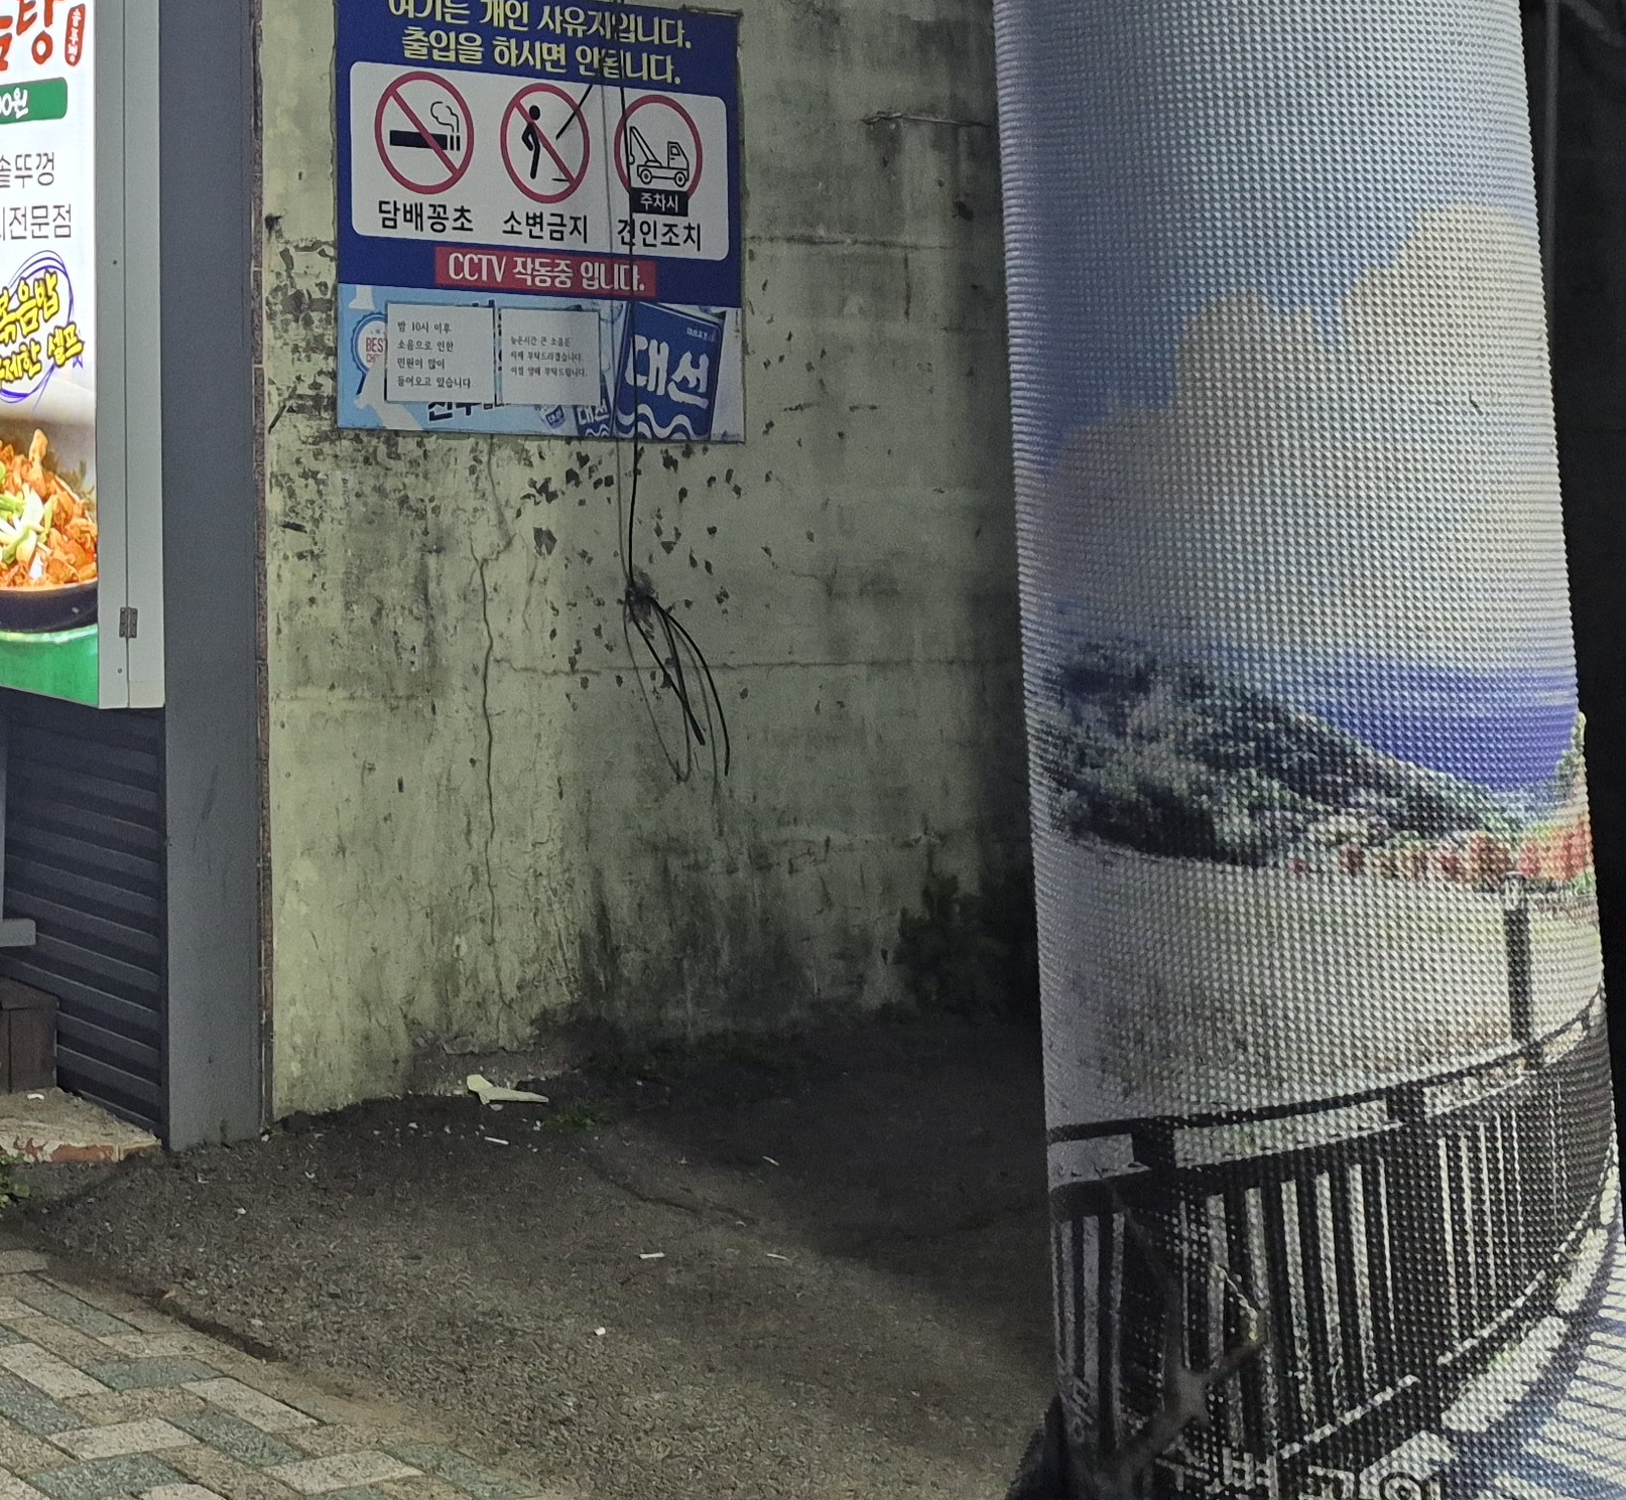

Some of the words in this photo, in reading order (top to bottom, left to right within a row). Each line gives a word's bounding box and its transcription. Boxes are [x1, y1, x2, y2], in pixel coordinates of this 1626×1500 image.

[536, 5, 693, 50] 사유지입니다.
[401, 27, 485, 66] 출입을
[492, 37, 568, 75] 하시면
[640, 191, 680, 214] 주차시
[377, 199, 474, 234] 담배꽁초
[501, 210, 589, 245] 소변금지
[616, 217, 702, 253] 견인조치
[447, 251, 508, 283] CCTV
[511, 256, 575, 290] 작동중
[580, 261, 646, 293] 입니다.
[412, 321, 429, 334] 10시
[433, 322, 452, 334] 이후
[45, 321, 86, 370] 셀프
[366, 337, 387, 353] BES
[397, 339, 433, 351] 소음으로
[436, 340, 454, 352] 인한
[397, 357, 423, 370] 민원이
[624, 333, 709, 410] 대선
[397, 375, 432, 388] 들어오고
